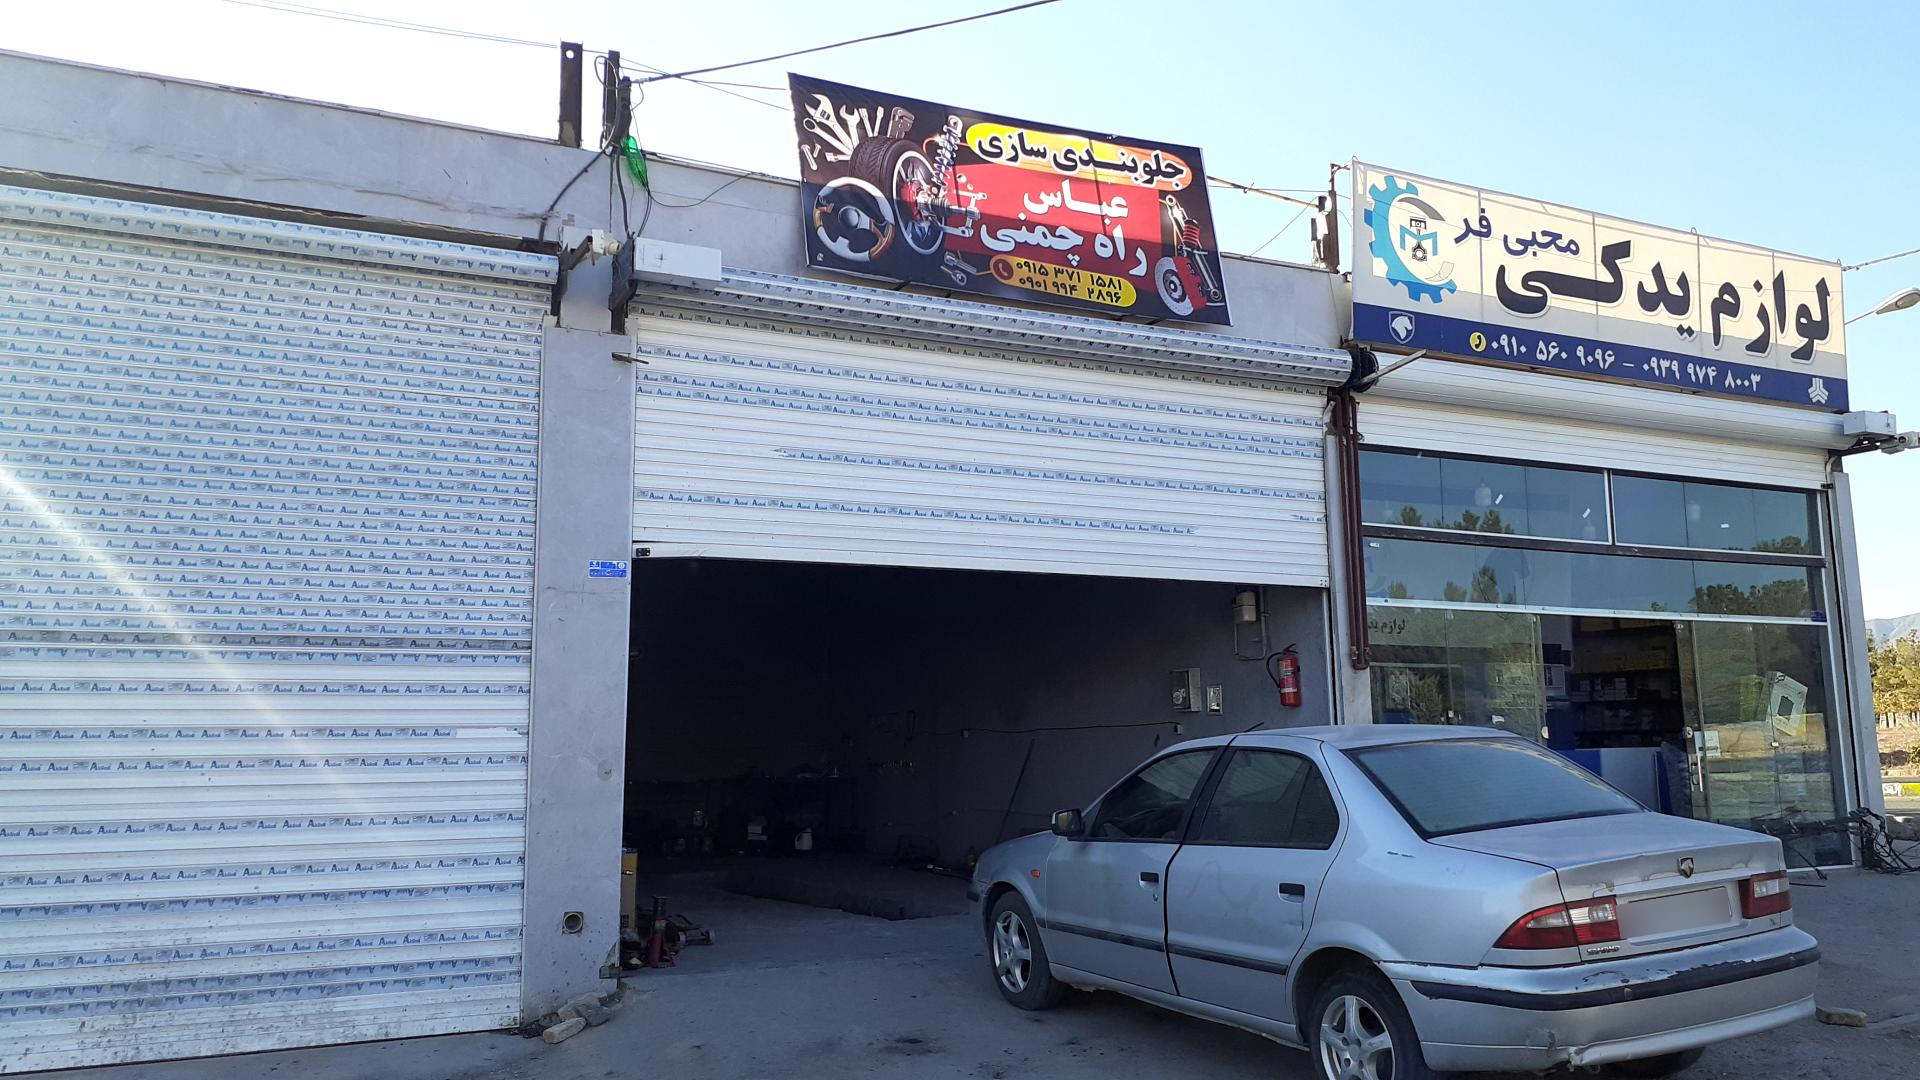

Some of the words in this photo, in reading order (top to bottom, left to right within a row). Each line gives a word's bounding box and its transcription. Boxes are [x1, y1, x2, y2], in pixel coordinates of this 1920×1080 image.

[977, 131, 1047, 162] سازی
[1023, 179, 1129, 225] عباس
[1453, 207, 1492, 244] فر
[980, 212, 1084, 267] چمنی
[1094, 224, 1148, 277] راه
[1503, 229, 1580, 257] محبی
[1016, 260, 1049, 277] ۰۹۱۵
[1053, 266, 1081, 283] ۳۷۱
[1089, 273, 1122, 291] ۱۵۸۱
[1495, 240, 1693, 338] یدکی
[1710, 270, 1831, 361] لوازم
[1491, 333, 1527, 357] ۰۹۱۰
[1535, 339, 1568, 362] ۵۶۰
[1576, 345, 1615, 370] ۹۰۹۶
[1642, 356, 1680, 380] ۰۹۳۹
[1686, 362, 1717, 386] ۹۷۴
[1724, 369, 1761, 392] ۸۰۰۳
